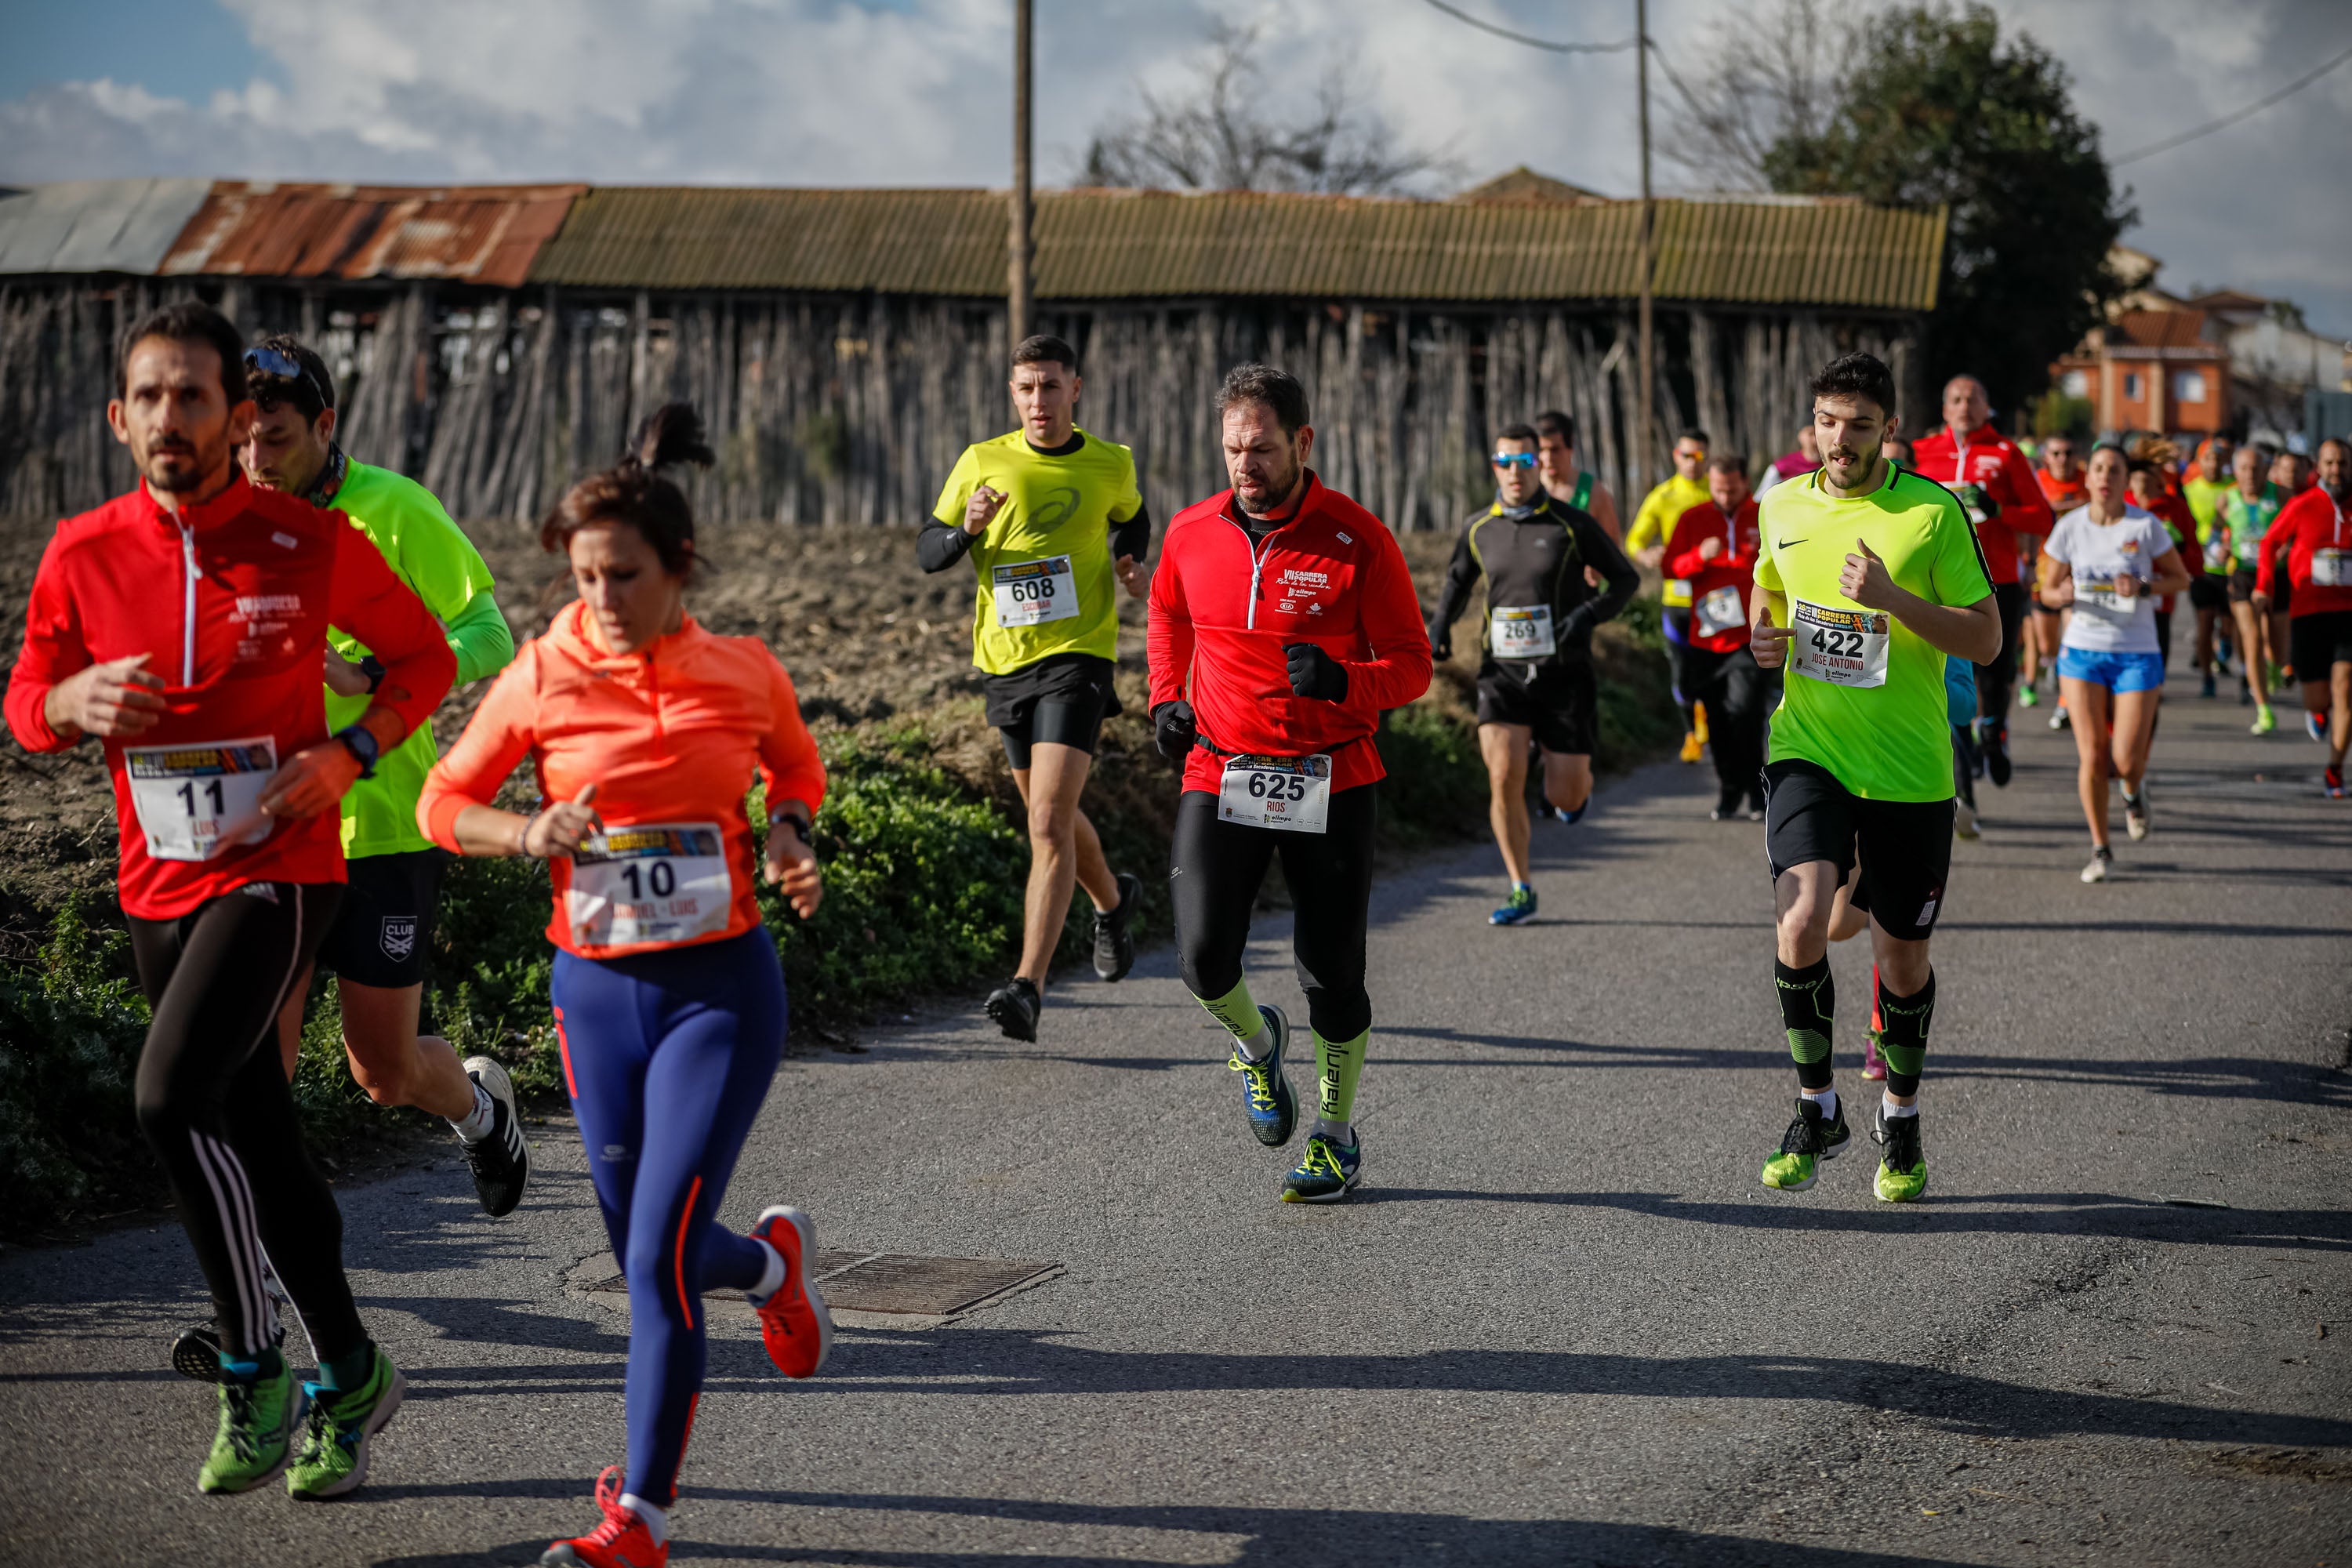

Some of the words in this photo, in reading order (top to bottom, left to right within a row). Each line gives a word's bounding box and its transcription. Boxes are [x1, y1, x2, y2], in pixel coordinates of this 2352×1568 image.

[1284, 568, 1294, 580] VII
[1012, 578, 1055, 602] 608
[1816, 618, 1834, 627] Secaderos
[1817, 608, 1851, 620] CARRERA
[1817, 614, 1851, 625] POPULAR
[1504, 621, 1537, 639] 269
[1811, 628, 1864, 658] 422
[1812, 652, 1827, 666] JOSE
[1828, 656, 1864, 670] ANTONIO
[1248, 772, 1305, 801] 625
[177, 779, 224, 816] 11
[1266, 800, 1286, 813] RIOS
[194, 819, 220, 836] LUIS
[622, 859, 676, 899] 10
[386, 924, 414, 935] CLUB
